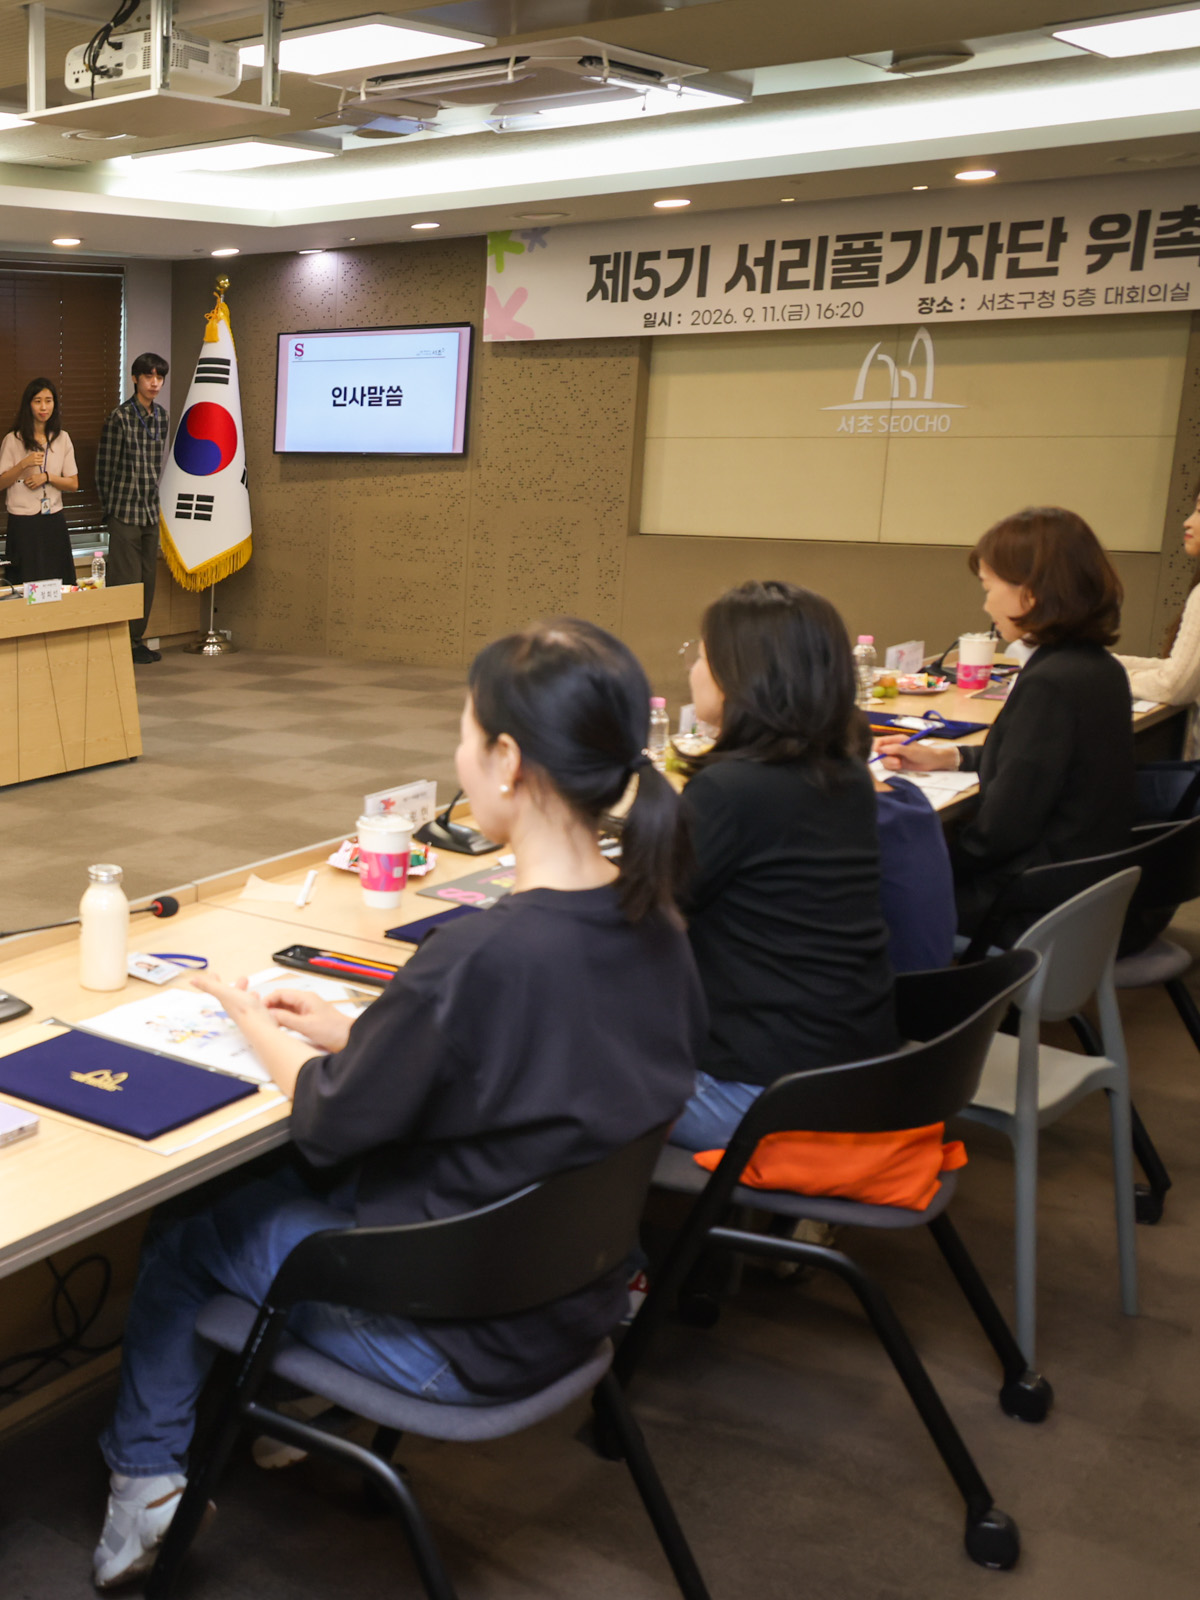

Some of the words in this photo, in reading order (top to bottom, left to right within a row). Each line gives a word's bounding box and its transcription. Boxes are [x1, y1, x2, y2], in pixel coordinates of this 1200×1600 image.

[586, 244, 711, 303] 제5기
[724, 216, 1068, 295] 서리풀기자단
[977, 289, 1056, 312] 서초구청
[1062, 287, 1097, 307] 5층
[1103, 281, 1191, 305] 대회의실
[690, 308, 738, 327] 2026.
[742, 306, 756, 324] 9.
[816, 301, 865, 320] 16:20
[294, 342, 305, 357] S
[331, 385, 404, 408] 인사말씀
[836, 414, 874, 434] 서초
[877, 414, 951, 433] SEOCHO
